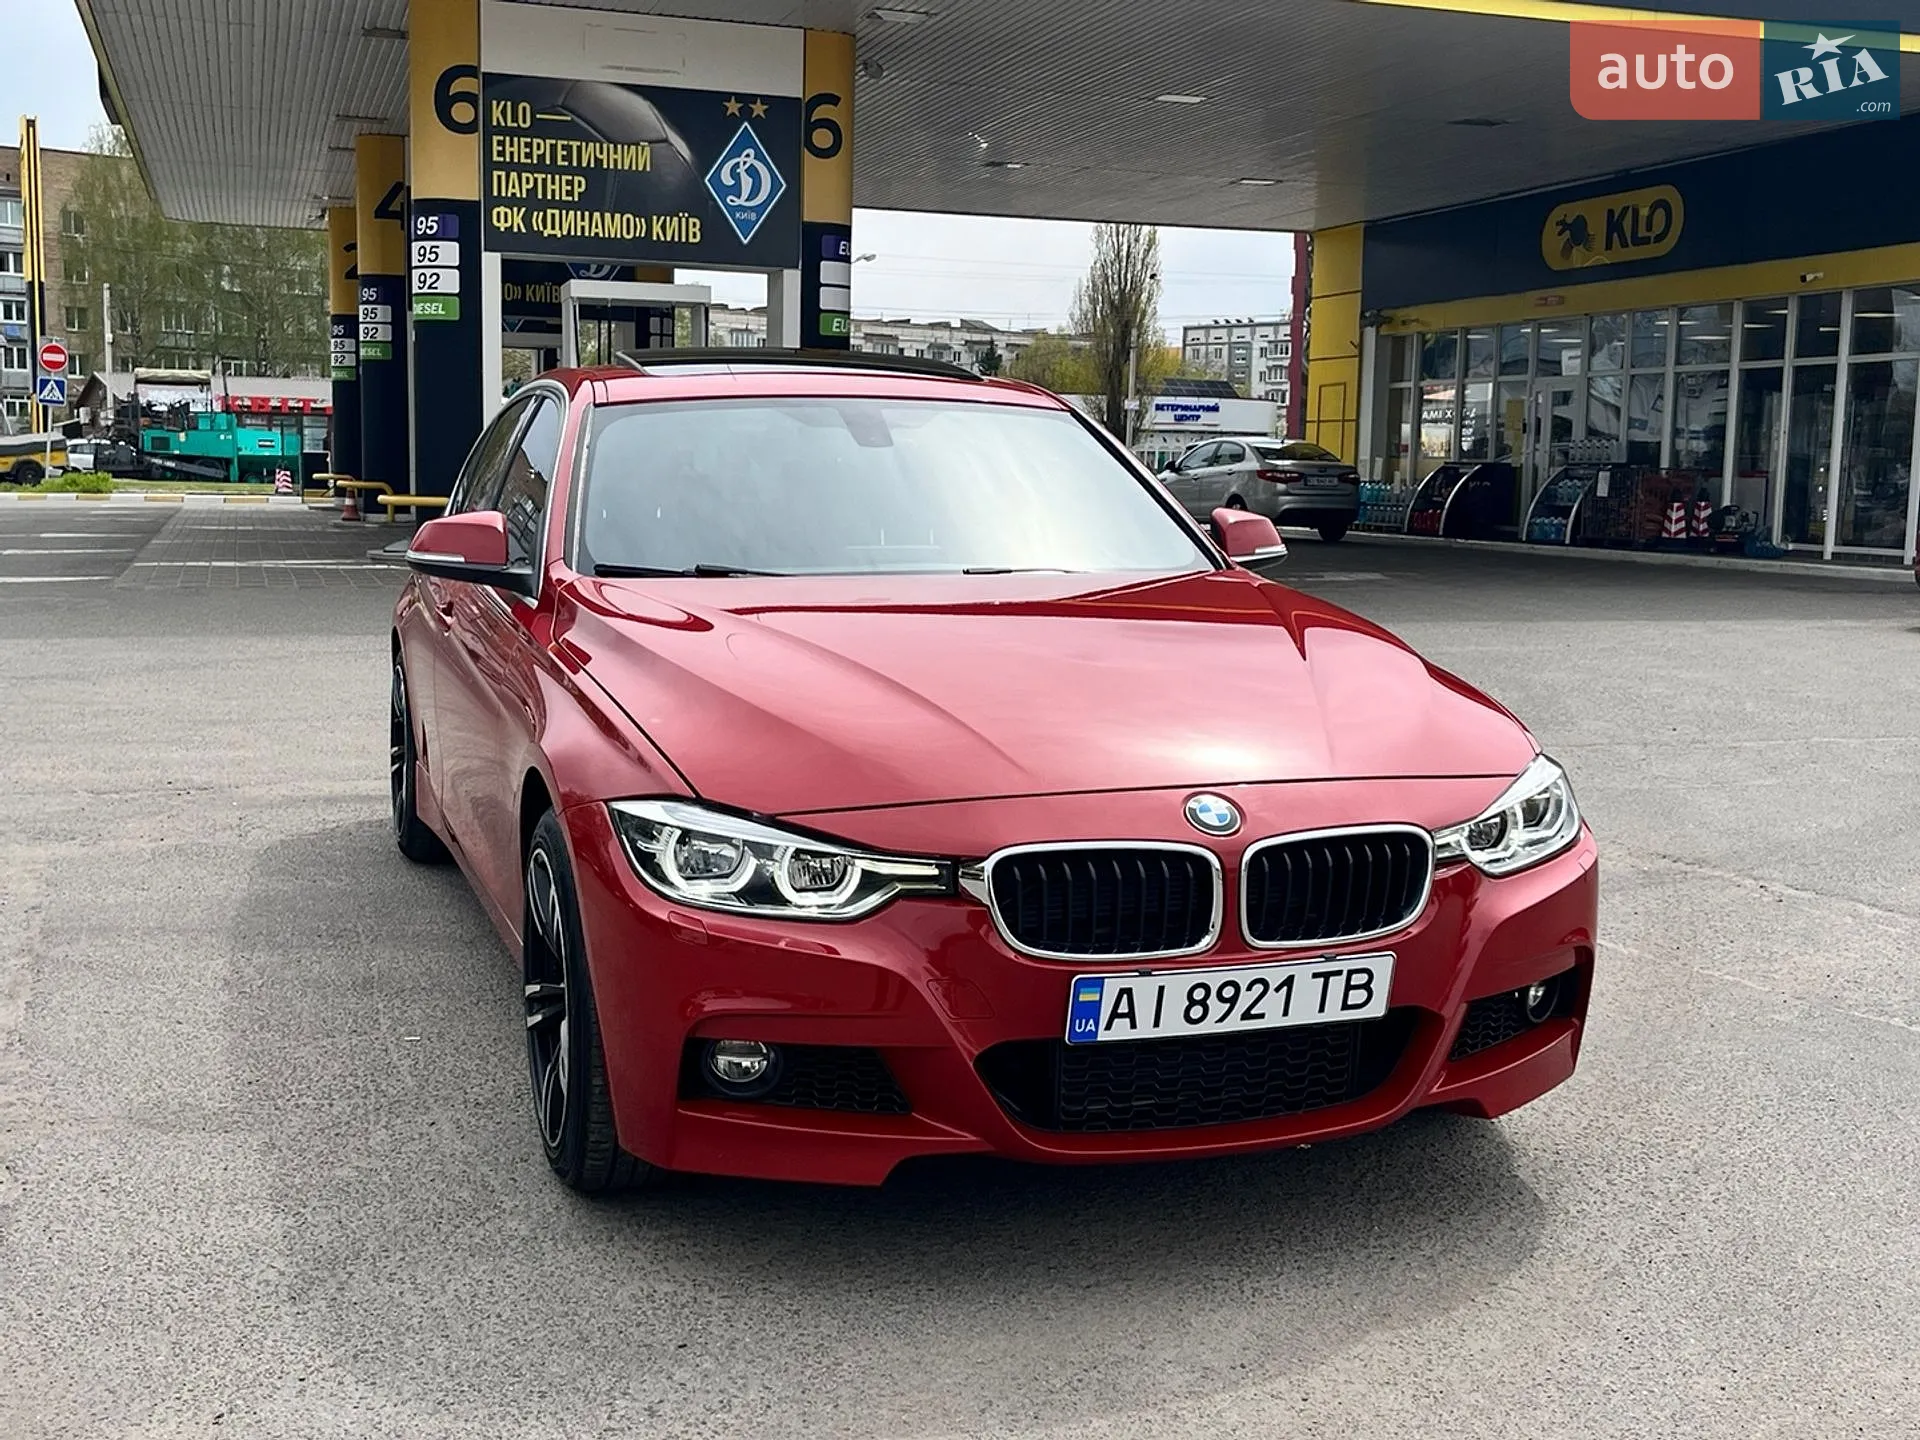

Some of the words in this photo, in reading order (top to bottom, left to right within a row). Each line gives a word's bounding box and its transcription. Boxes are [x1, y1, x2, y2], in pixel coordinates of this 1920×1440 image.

[433, 64, 479, 135] 6
[491, 99, 531, 128] KLO
[804, 92, 843, 160] 6
[491, 135, 651, 172] ЕНЕРГЕТИЧНИЙ
[491, 170, 586, 202] ПАРТНЕР
[416, 216, 439, 235] 95
[491, 206, 527, 233] ФК
[531, 208, 647, 240] «ДИНАМО»
[652, 213, 701, 243] КИЇВ
[1604, 198, 1673, 252] KLO
[417, 245, 440, 263] 95
[361, 287, 378, 301] 95
[417, 272, 441, 290] 92
[362, 307, 378, 321] 95
[362, 326, 379, 339] 92
[1104, 985, 1165, 1032] AI
[1182, 973, 1296, 1027] 8921
[1311, 966, 1374, 1015] TB
[1075, 1018, 1096, 1034] UA
